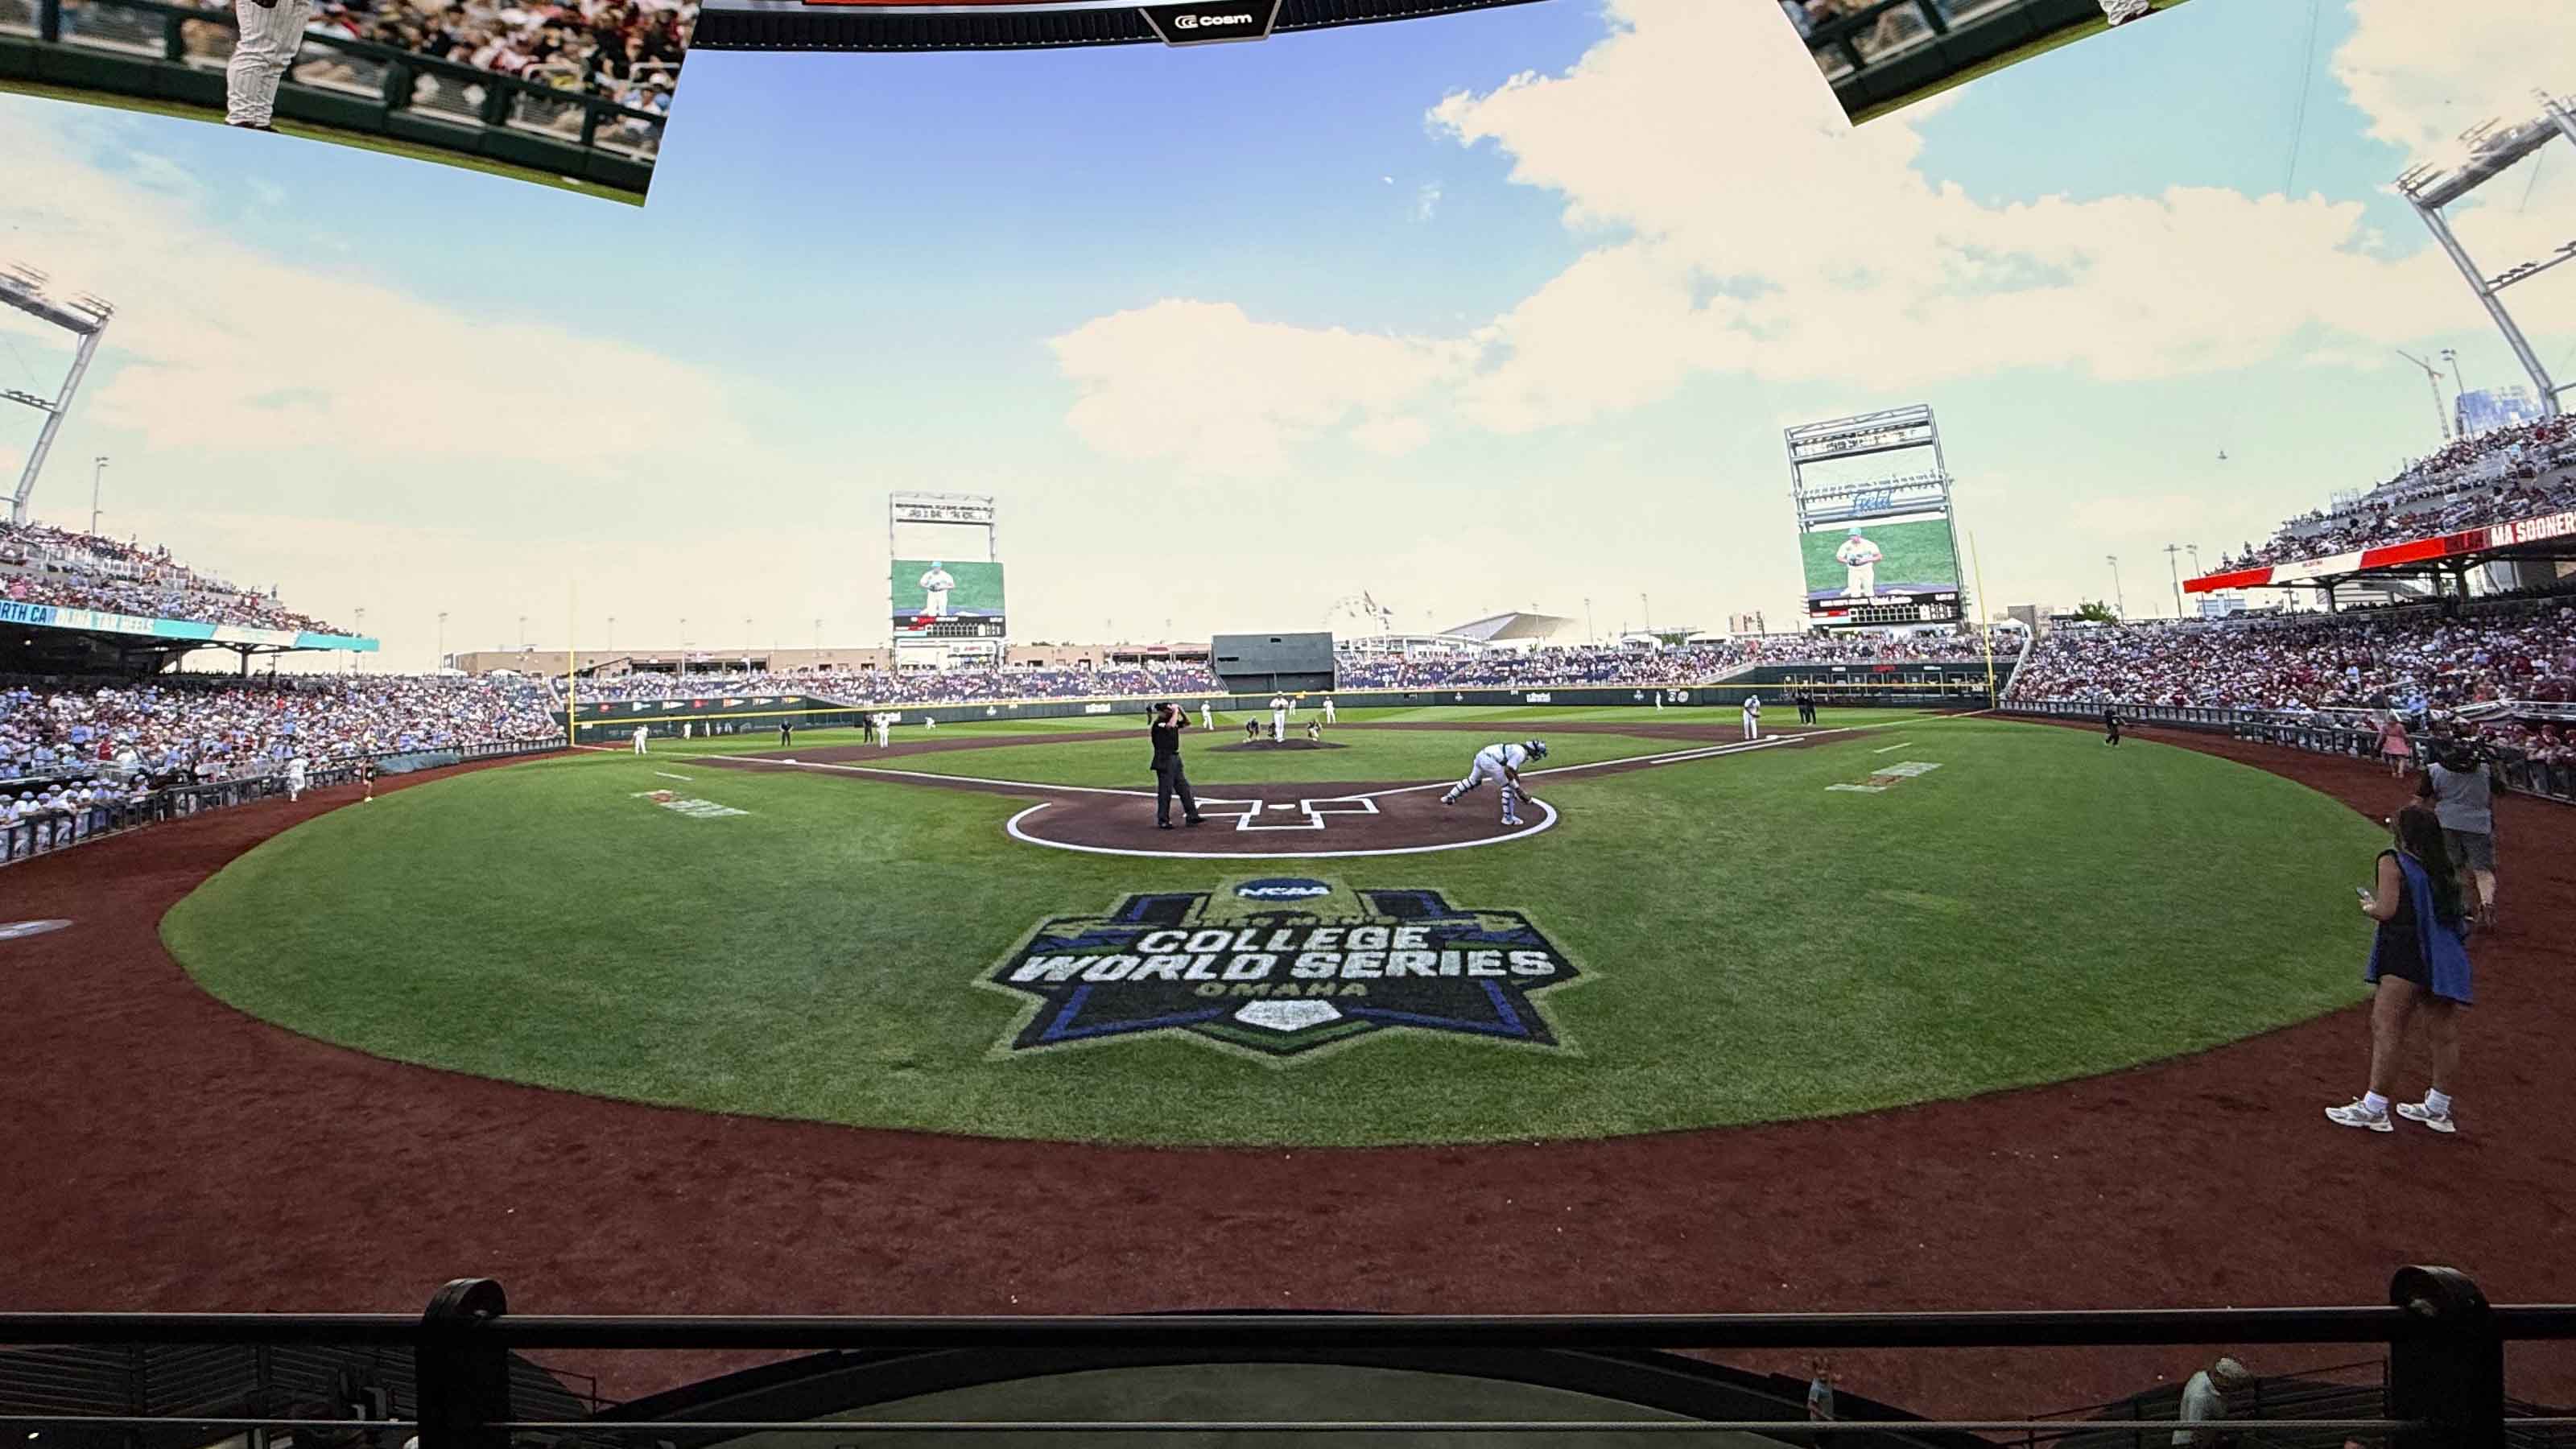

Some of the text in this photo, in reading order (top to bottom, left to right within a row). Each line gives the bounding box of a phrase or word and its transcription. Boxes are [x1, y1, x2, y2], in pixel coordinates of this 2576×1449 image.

[2516, 511, 2576, 543] SOONER
[0, 601, 28, 620] RTH
[1238, 886, 1330, 897] NCAA
[1136, 926, 1431, 953] COLLEGE
[1009, 949, 1555, 982] WORLD SERIES
[1194, 981, 1368, 997] OMAHA
